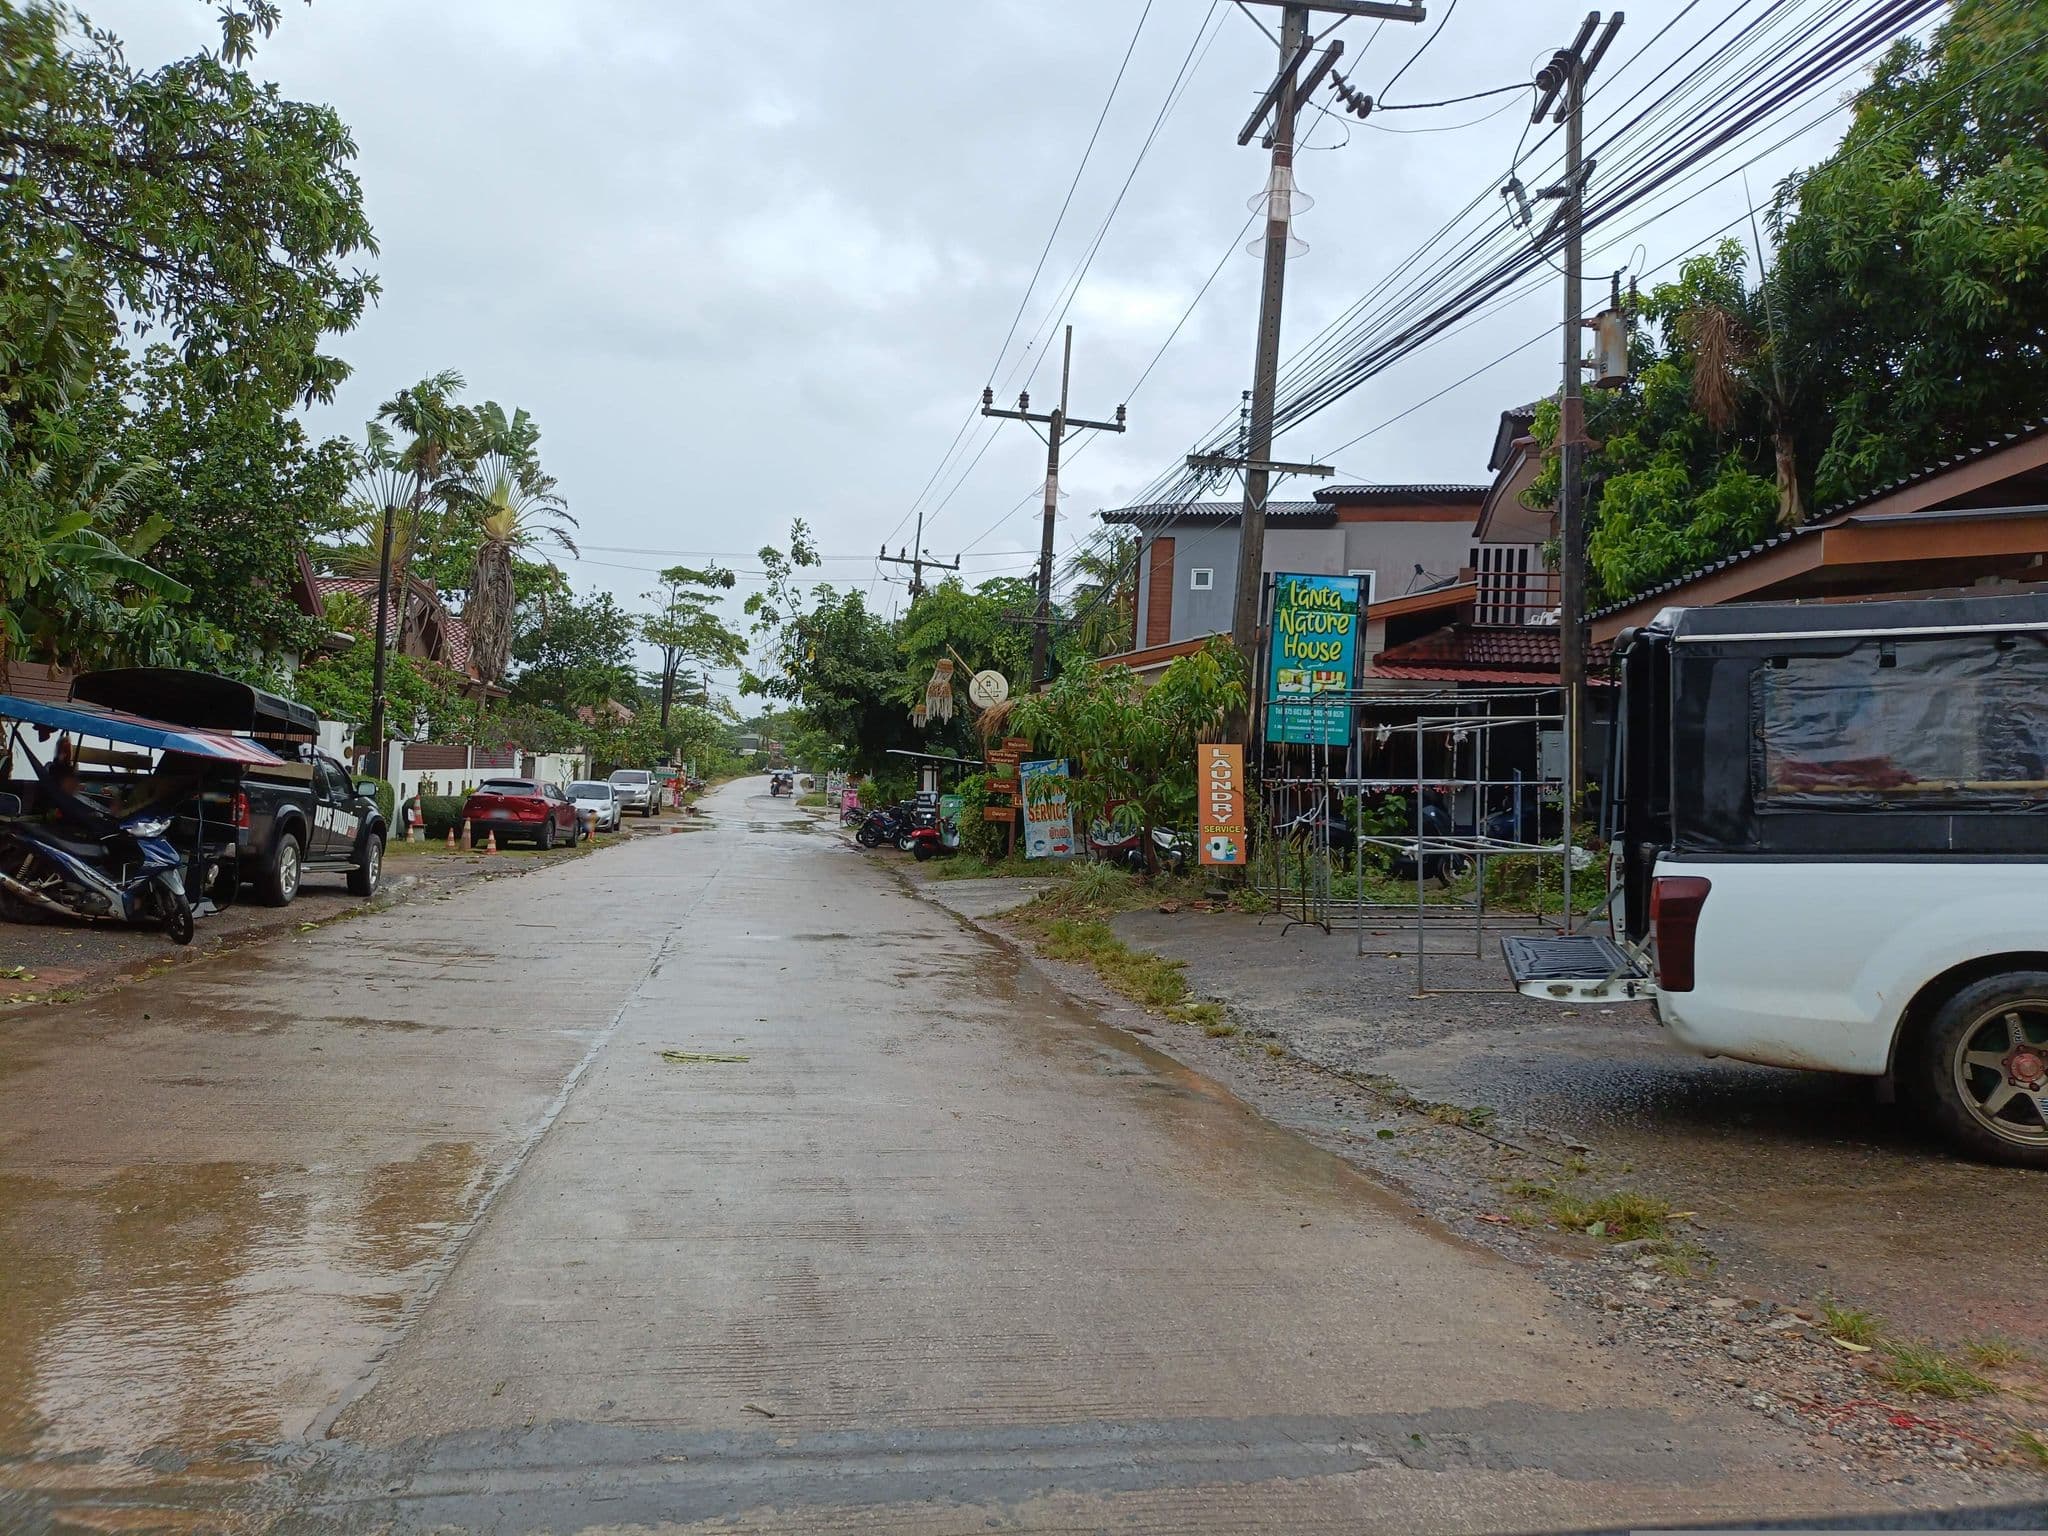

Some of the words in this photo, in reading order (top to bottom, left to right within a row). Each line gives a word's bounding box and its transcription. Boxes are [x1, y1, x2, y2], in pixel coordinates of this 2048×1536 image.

[1290, 580, 1341, 611] Lanta
[1280, 607, 1349, 635] Nature
[1284, 633, 1342, 661] House
[1210, 748, 1233, 823] LAUNDRY
[1028, 803, 1067, 822] SERVICE
[1204, 825, 1240, 833] SERVICE
